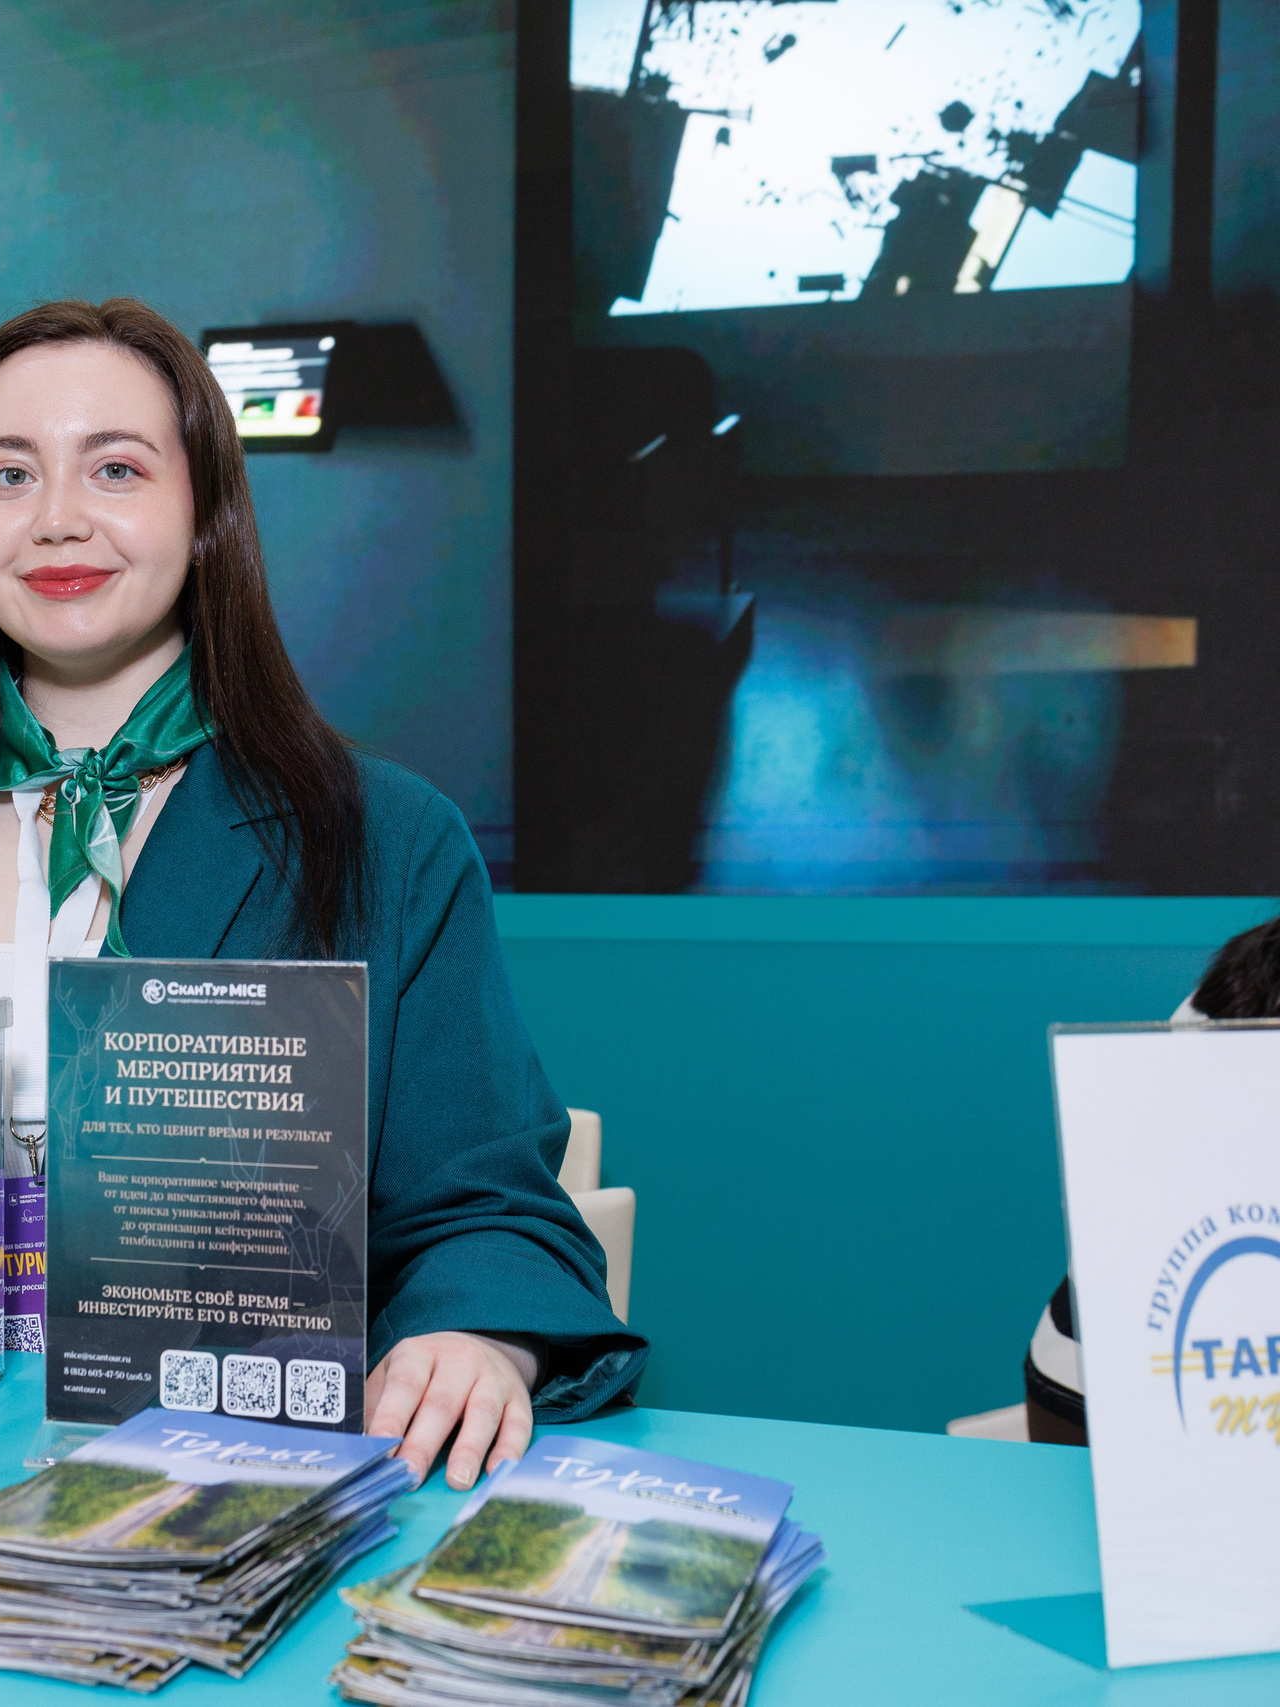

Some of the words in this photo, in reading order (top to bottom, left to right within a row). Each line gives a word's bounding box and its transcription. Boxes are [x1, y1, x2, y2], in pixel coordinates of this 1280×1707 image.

[229, 983, 267, 997] MICE
[103, 1032, 307, 1057] КОРПОРАТИВНЫЕ
[116, 1059, 293, 1084] МЕРОПРИЯТИЯ
[105, 1086, 121, 1104] И
[128, 1087, 305, 1112] ПУТЕШЕСТВИЯ
[81, 1120, 106, 1133] ДЛЯ
[108, 1122, 134, 1135] ТЕХ,
[136, 1123, 161, 1135] КТО
[163, 1124, 206, 1137] ЦЕНИТ
[208, 1126, 249, 1139] ВРЕМЯ
[253, 1128, 263, 1139] И
[265, 1129, 332, 1143] РЕЗУЛЬТАТ
[98, 1171, 128, 1184] Ваше
[131, 1174, 218, 1189] корпоративное
[220, 1179, 300, 1194] мероприятие
[104, 1188, 118, 1198] от
[120, 1189, 148, 1200] идеи
[150, 1190, 165, 1202] до
[167, 1192, 258, 1208] впечатляющего
[259, 1196, 307, 1210] финала,
[113, 1204, 127, 1214] от
[129, 1205, 170, 1217] поиска
[172, 1207, 240, 1221] уникальной
[243, 1210, 293, 1224] локации
[121, 1220, 136, 1231] до
[138, 1221, 212, 1235] организации
[215, 1225, 285, 1240] кейтеринга,
[120, 1234, 195, 1250] тимбилдинга
[198, 1240, 206, 1250] и
[208, 1241, 291, 1256] конференции.
[1147, 1215, 1219, 1333] группа
[102, 1285, 192, 1304] ЭКОНОМЬТЕ
[195, 1290, 235, 1306] СВОЁ
[238, 1293, 289, 1310] ВРЕМЯ
[78, 1300, 194, 1321] ИНВЕСТИРУЙТЕ
[197, 1309, 225, 1323] ЕГО
[229, 1310, 239, 1324] В
[241, 1311, 332, 1331] СТРАТЕГИЮ
[64, 1351, 131, 1363] mice@scantour.ru
[64, 1366, 69, 1375] 8
[64, 1384, 106, 1395] scantour.ru
